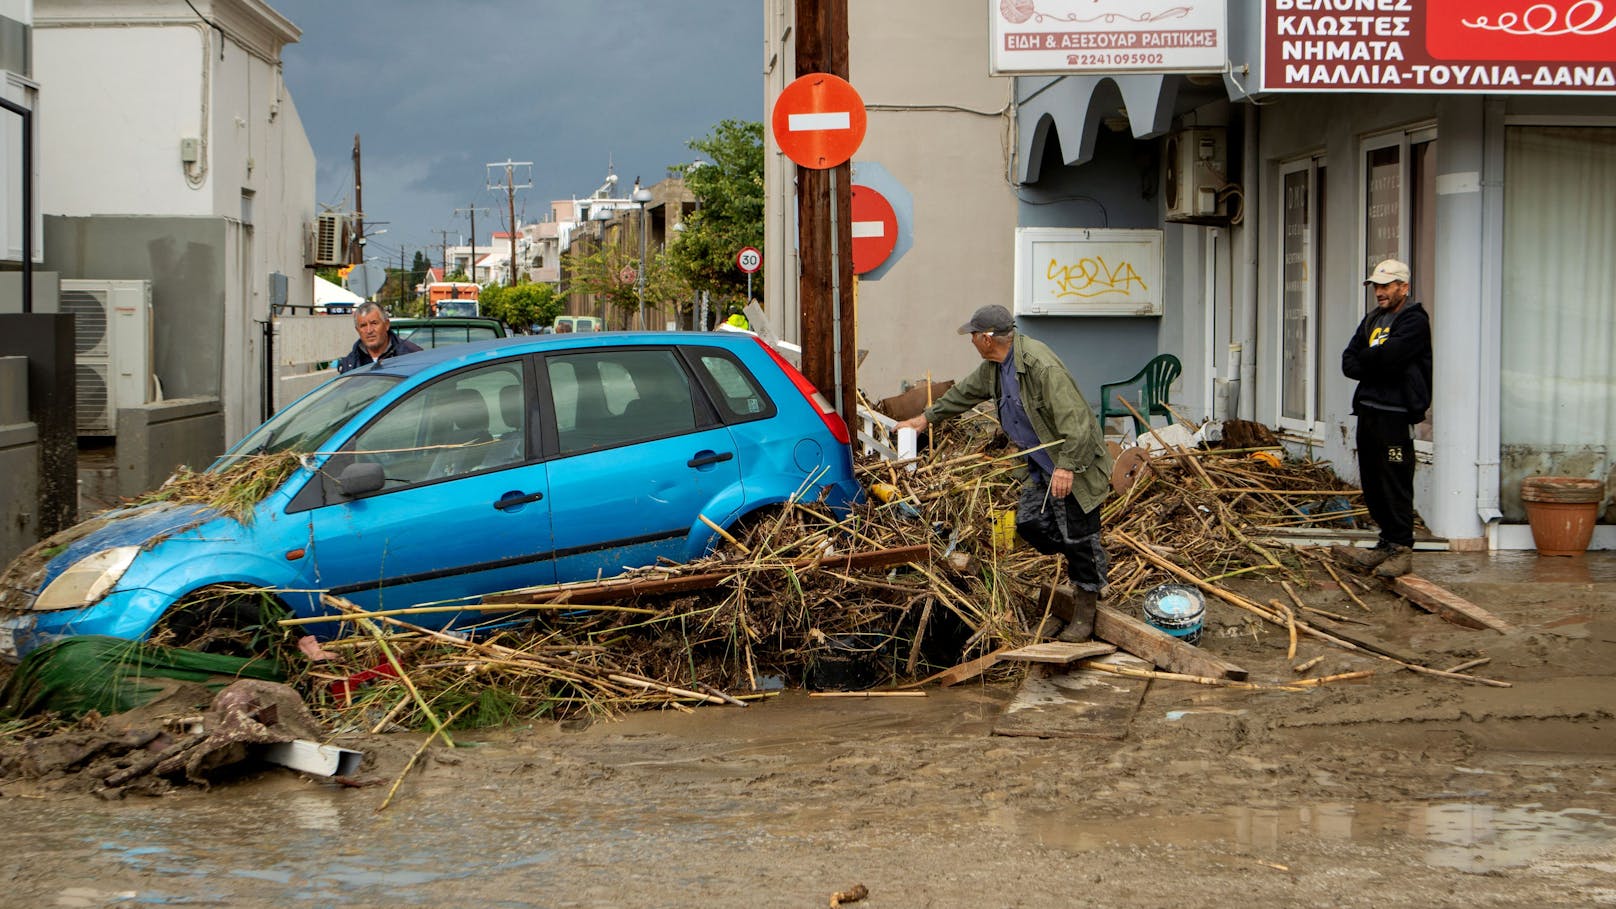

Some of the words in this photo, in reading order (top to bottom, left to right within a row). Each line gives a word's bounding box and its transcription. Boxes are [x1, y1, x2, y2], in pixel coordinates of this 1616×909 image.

[1277, 15, 1410, 36] ΚΛΩΣΤΕΣ
[1007, 33, 1040, 49] ΕΙΔΗ
[1045, 33, 1056, 48] &
[1061, 32, 1137, 48] ΑΞΕΣΟΥΑΡ
[1142, 31, 1213, 47] ΡΑΠΤΙΚΗΣ
[1080, 53, 1164, 65] 2241095902
[1282, 40, 1404, 61] ΝΗΜΑΤΑ
[742, 255, 757, 265] 30
